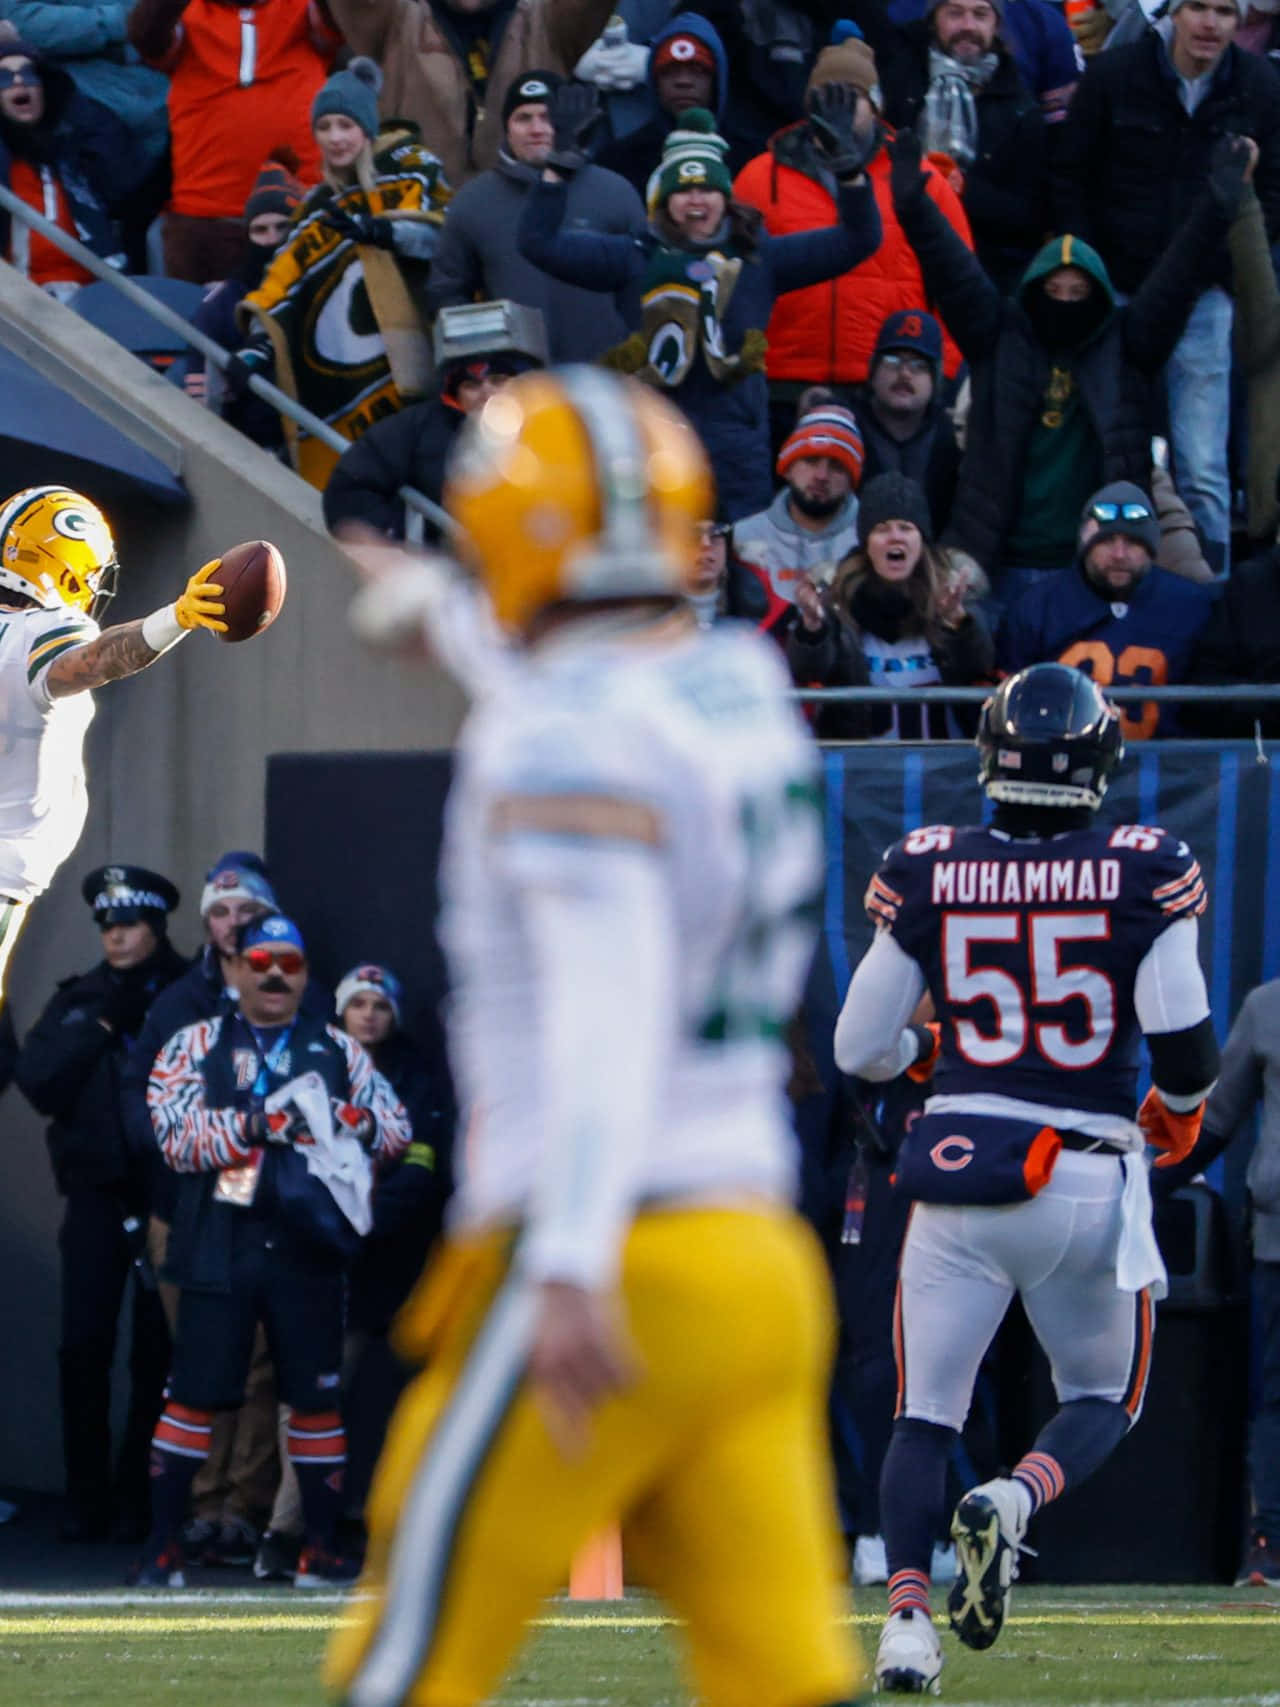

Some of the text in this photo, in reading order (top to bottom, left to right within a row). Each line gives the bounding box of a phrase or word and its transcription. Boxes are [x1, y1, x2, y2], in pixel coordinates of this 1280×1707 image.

[931, 859, 1121, 905] MUHAMMAD
[941, 909, 1116, 1071] 55
[929, 1135, 975, 1171] C
